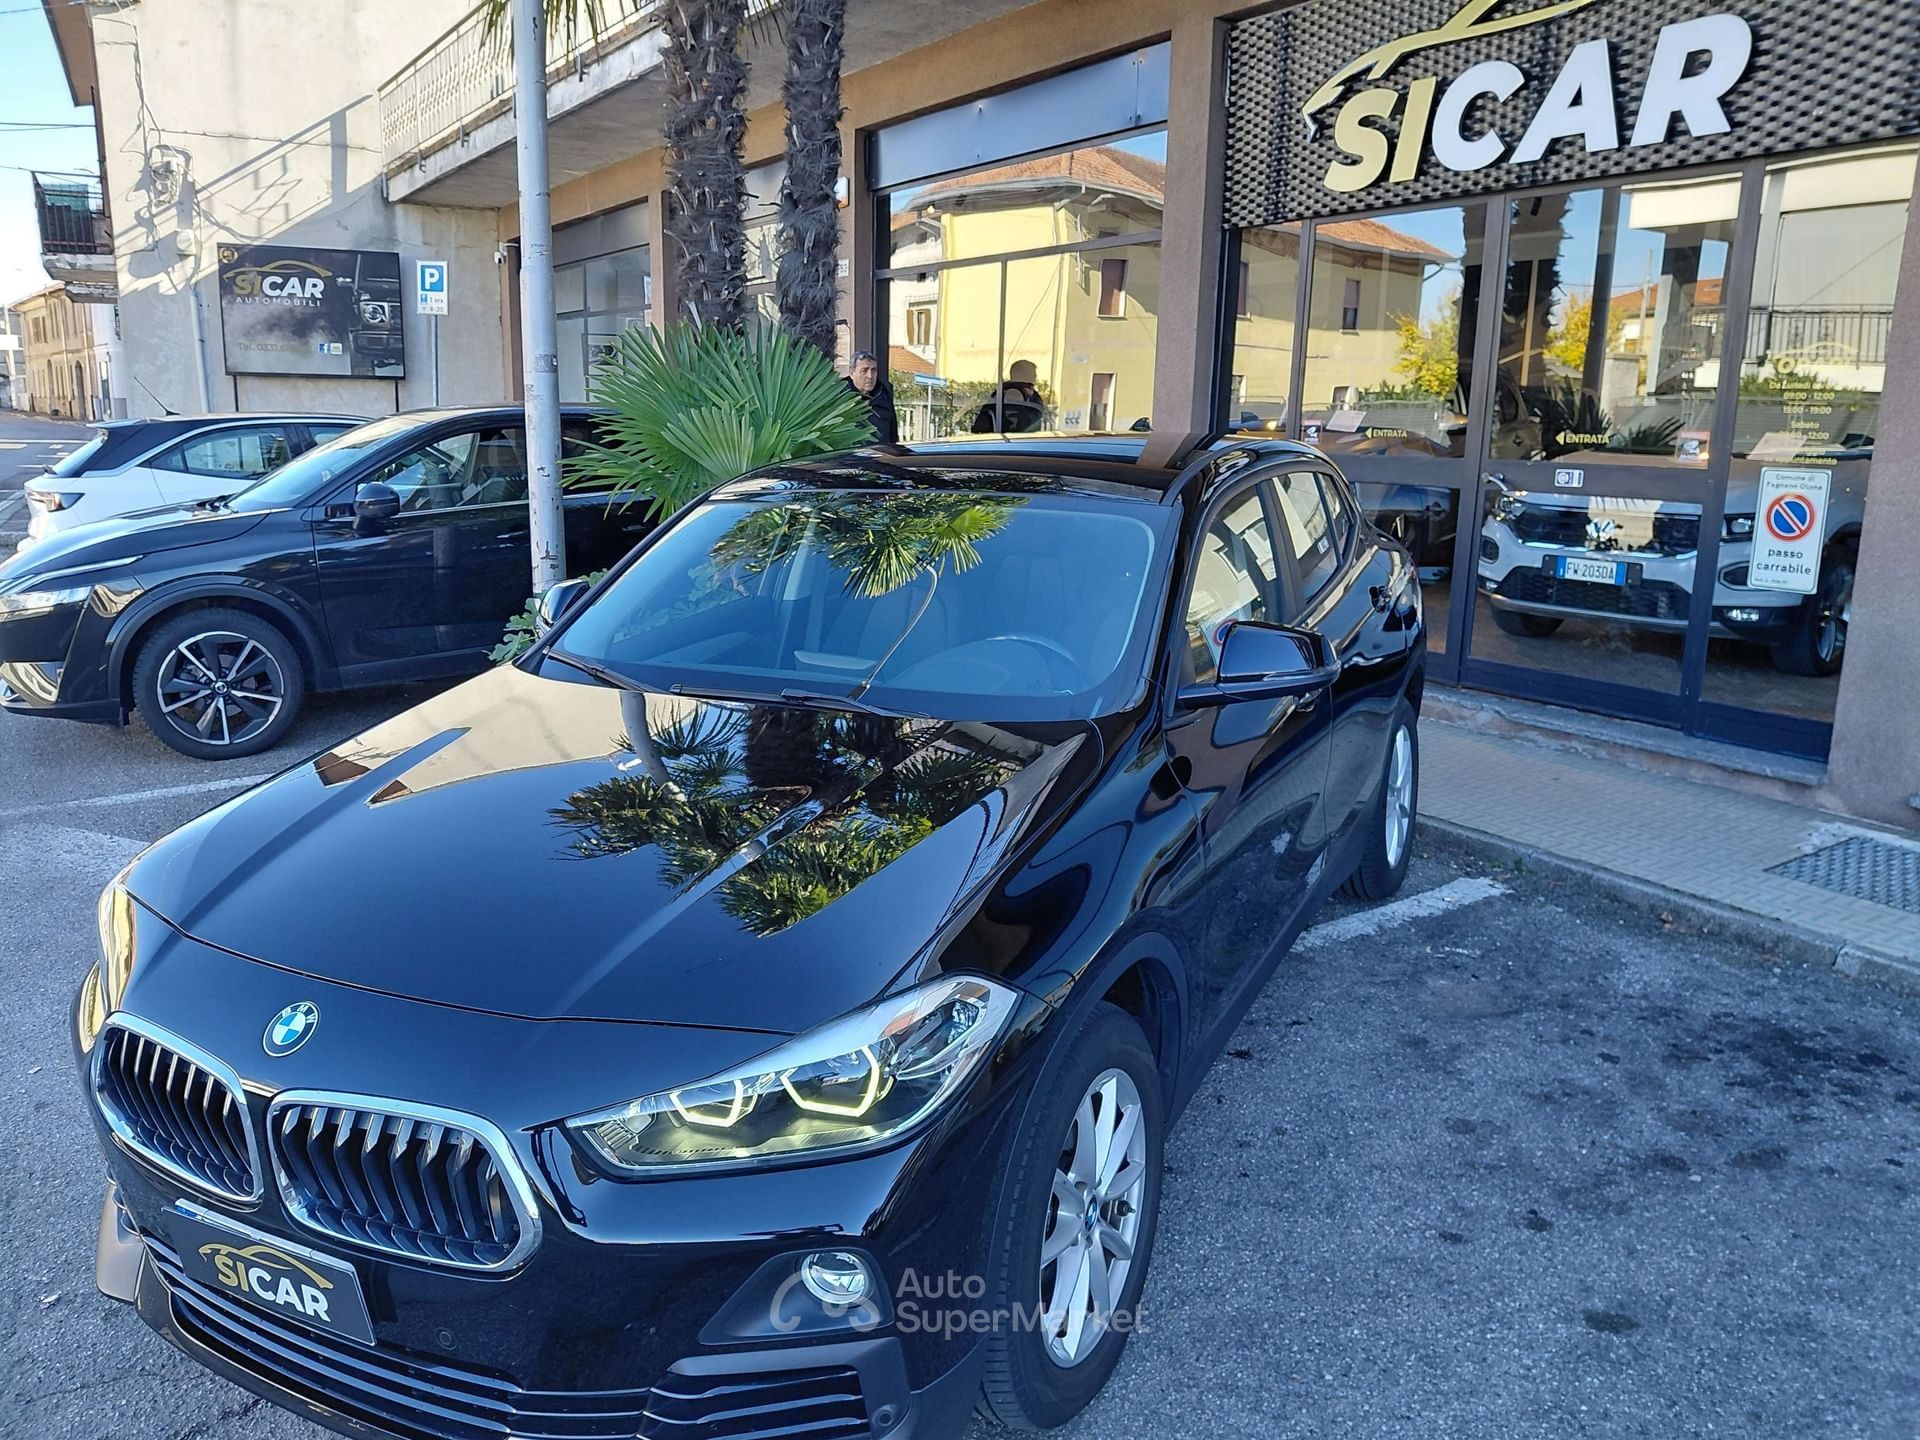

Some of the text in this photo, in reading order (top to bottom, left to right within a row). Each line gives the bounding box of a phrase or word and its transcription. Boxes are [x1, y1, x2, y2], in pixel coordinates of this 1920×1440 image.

[1323, 14, 1753, 193] SICAR
[234, 274, 325, 299] SICAR
[424, 268, 440, 290] P
[235, 296, 321, 307] AUTOMOBILI
[1373, 428, 1408, 438] ENTRATA
[1565, 433, 1610, 445] ENTRATA
[1767, 548, 1804, 559] passo
[1756, 562, 1812, 576] carrabile
[280, 1003, 317, 1024] BMW
[214, 1254, 332, 1323] SICAR
